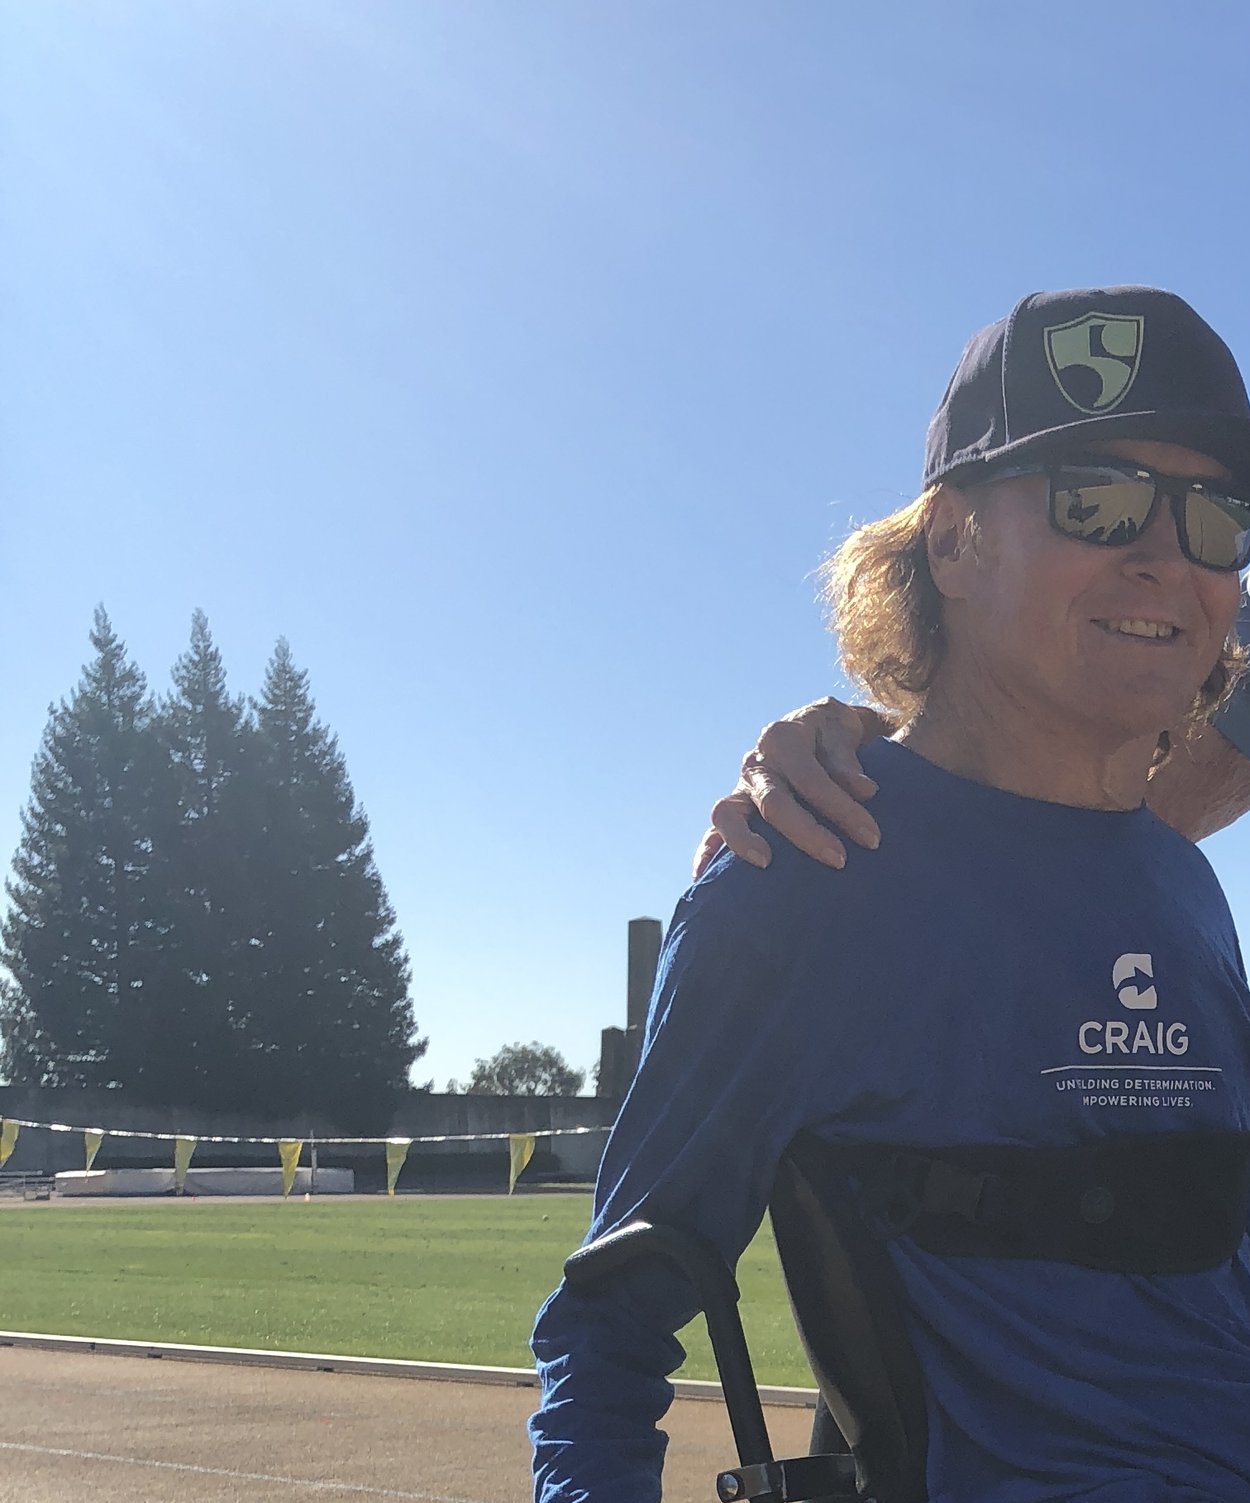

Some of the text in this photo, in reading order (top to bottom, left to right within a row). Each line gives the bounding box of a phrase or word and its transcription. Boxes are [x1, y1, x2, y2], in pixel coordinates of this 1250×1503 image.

[1078, 1020, 1189, 1056] CRAIG
[1124, 1079, 1216, 1091] DETERMINATION.
[1082, 1096, 1160, 1107] MPOWERING
